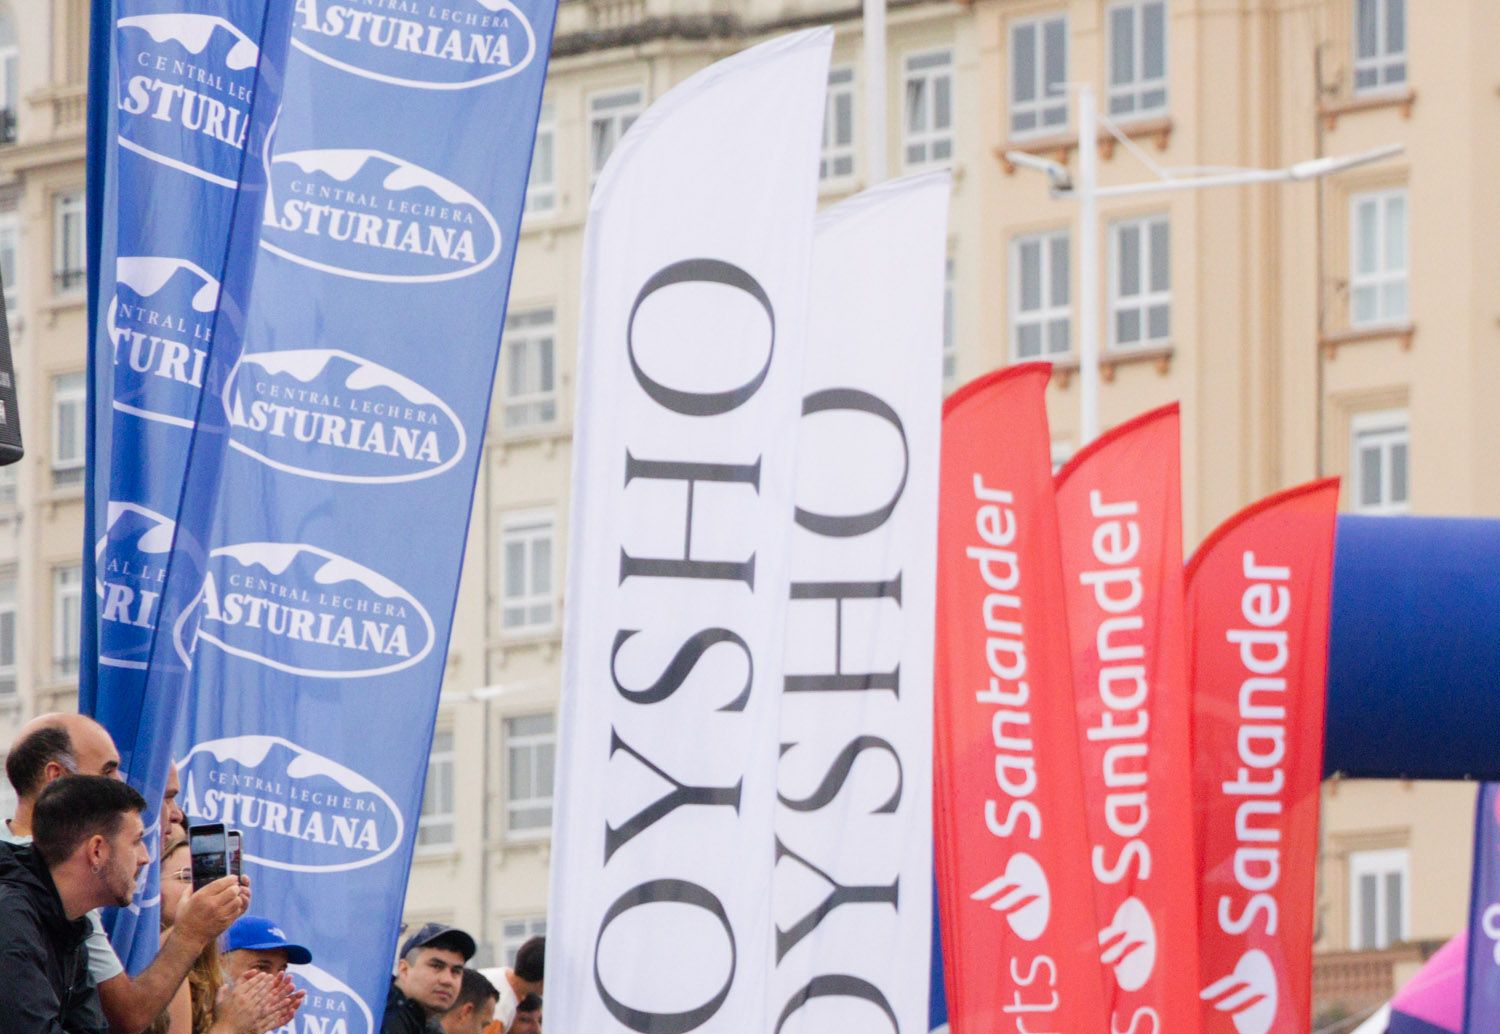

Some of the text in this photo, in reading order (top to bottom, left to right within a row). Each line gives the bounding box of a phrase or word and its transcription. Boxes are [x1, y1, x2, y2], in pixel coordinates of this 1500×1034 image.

[429, 4, 509, 28] LECHERA
[138, 51, 223, 91] CENTRAL
[290, 180, 474, 224] CENTRAL LECHERA
[120, 303, 186, 333] NTRAL
[256, 381, 439, 425] CENTRAL LECHERA
[200, 571, 411, 657] ASTURIANA
[230, 574, 407, 619] CENTRAL LECHERA
[966, 473, 1042, 840] Santander
[1079, 489, 1151, 885] Santander
[1218, 550, 1292, 937] Santander
[182, 769, 380, 852] ASTURIANA
[209, 769, 377, 813] CENTRAL LECHERA
